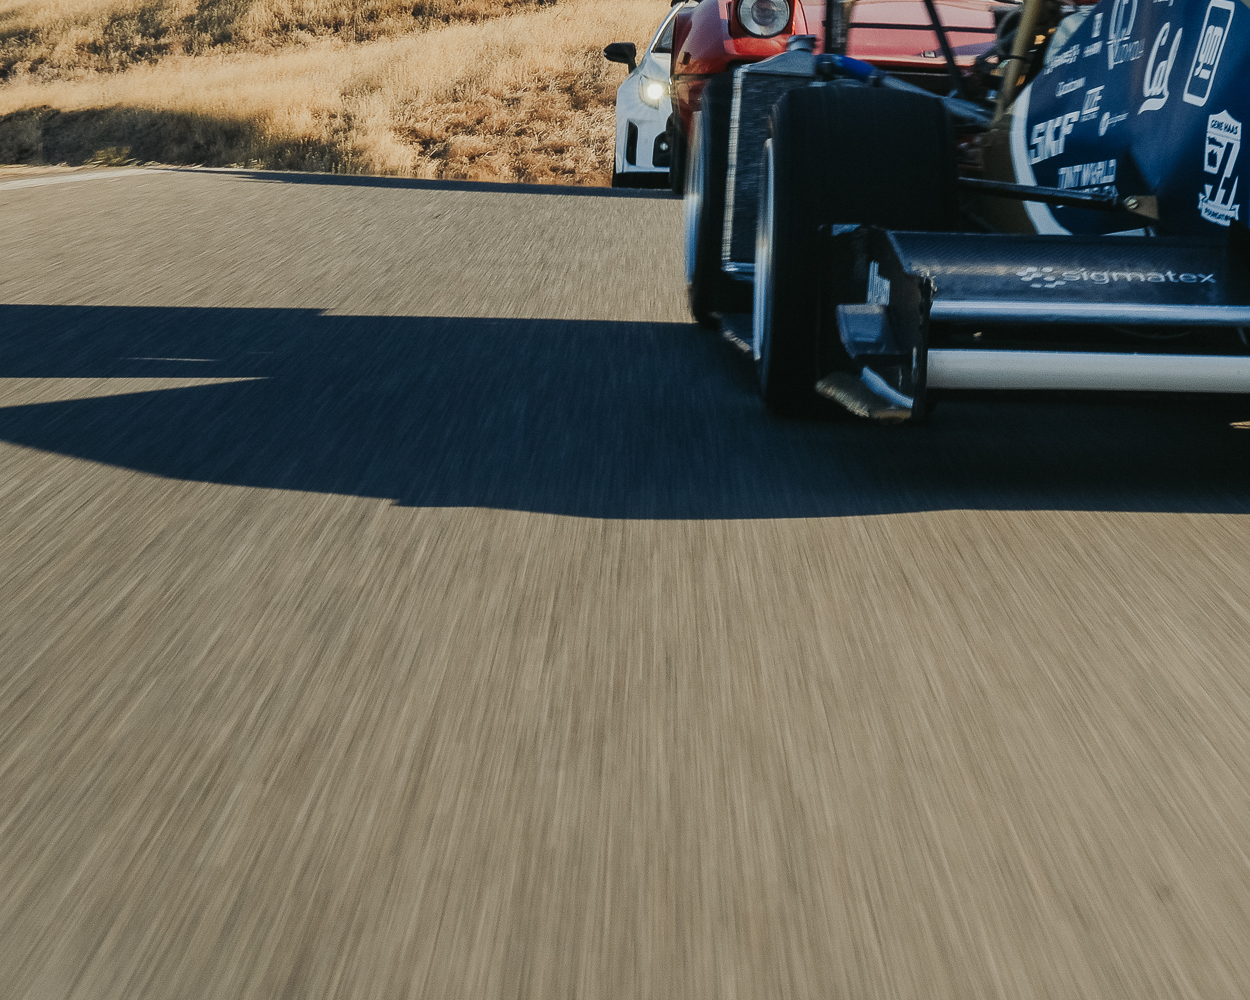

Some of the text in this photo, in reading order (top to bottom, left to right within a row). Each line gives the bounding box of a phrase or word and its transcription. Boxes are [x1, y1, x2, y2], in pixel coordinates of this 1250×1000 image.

[1210, 119, 1239, 135] GENE HAAS
[1030, 110, 1080, 166] SKF
[1062, 267, 1217, 285] sigmatex
